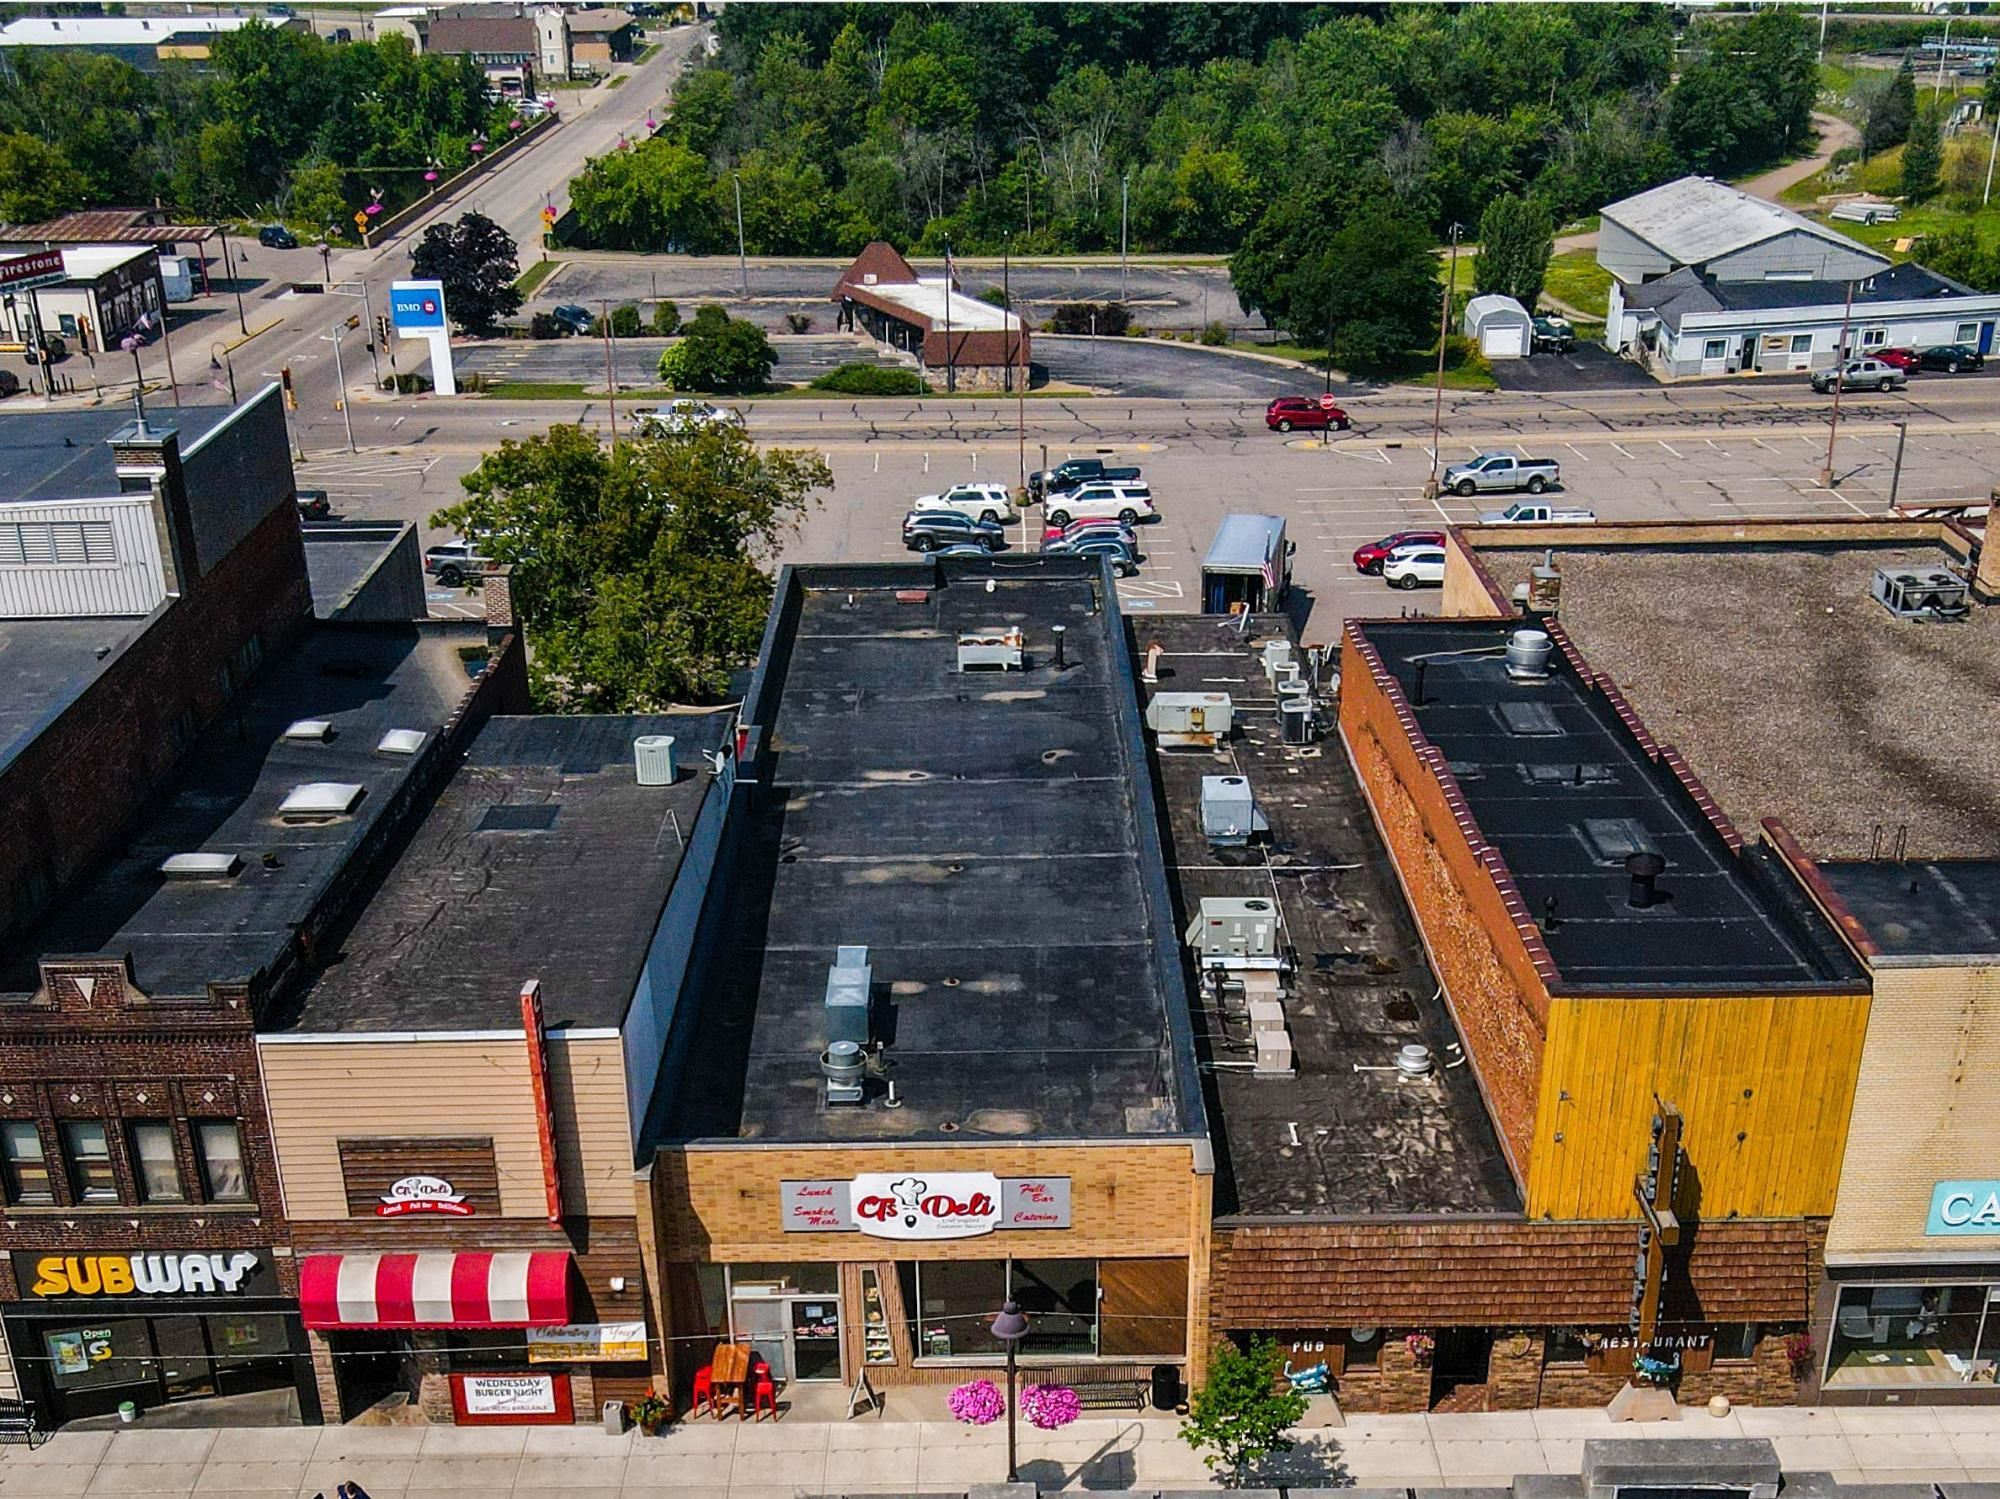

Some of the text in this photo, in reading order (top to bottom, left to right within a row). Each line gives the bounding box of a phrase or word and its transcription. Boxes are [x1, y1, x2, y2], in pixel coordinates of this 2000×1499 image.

[396, 303, 420, 312] BMO
[796, 1186, 833, 1197] Lunch
[1019, 1183, 1046, 1194] Full
[1031, 1194, 1055, 1203] Bar
[920, 1192, 995, 1218] Deli
[793, 1206, 836, 1217] Smoked
[807, 1216, 840, 1226] Meats
[1013, 1212, 1059, 1223] Catering
[32, 1251, 259, 1297] SUBWAY
[83, 1329, 112, 1340] Open
[1292, 1340, 1325, 1353] PUB
[475, 1379, 541, 1388] WEDNESDAY
[475, 1388, 544, 1397] BURGER NIGHT
